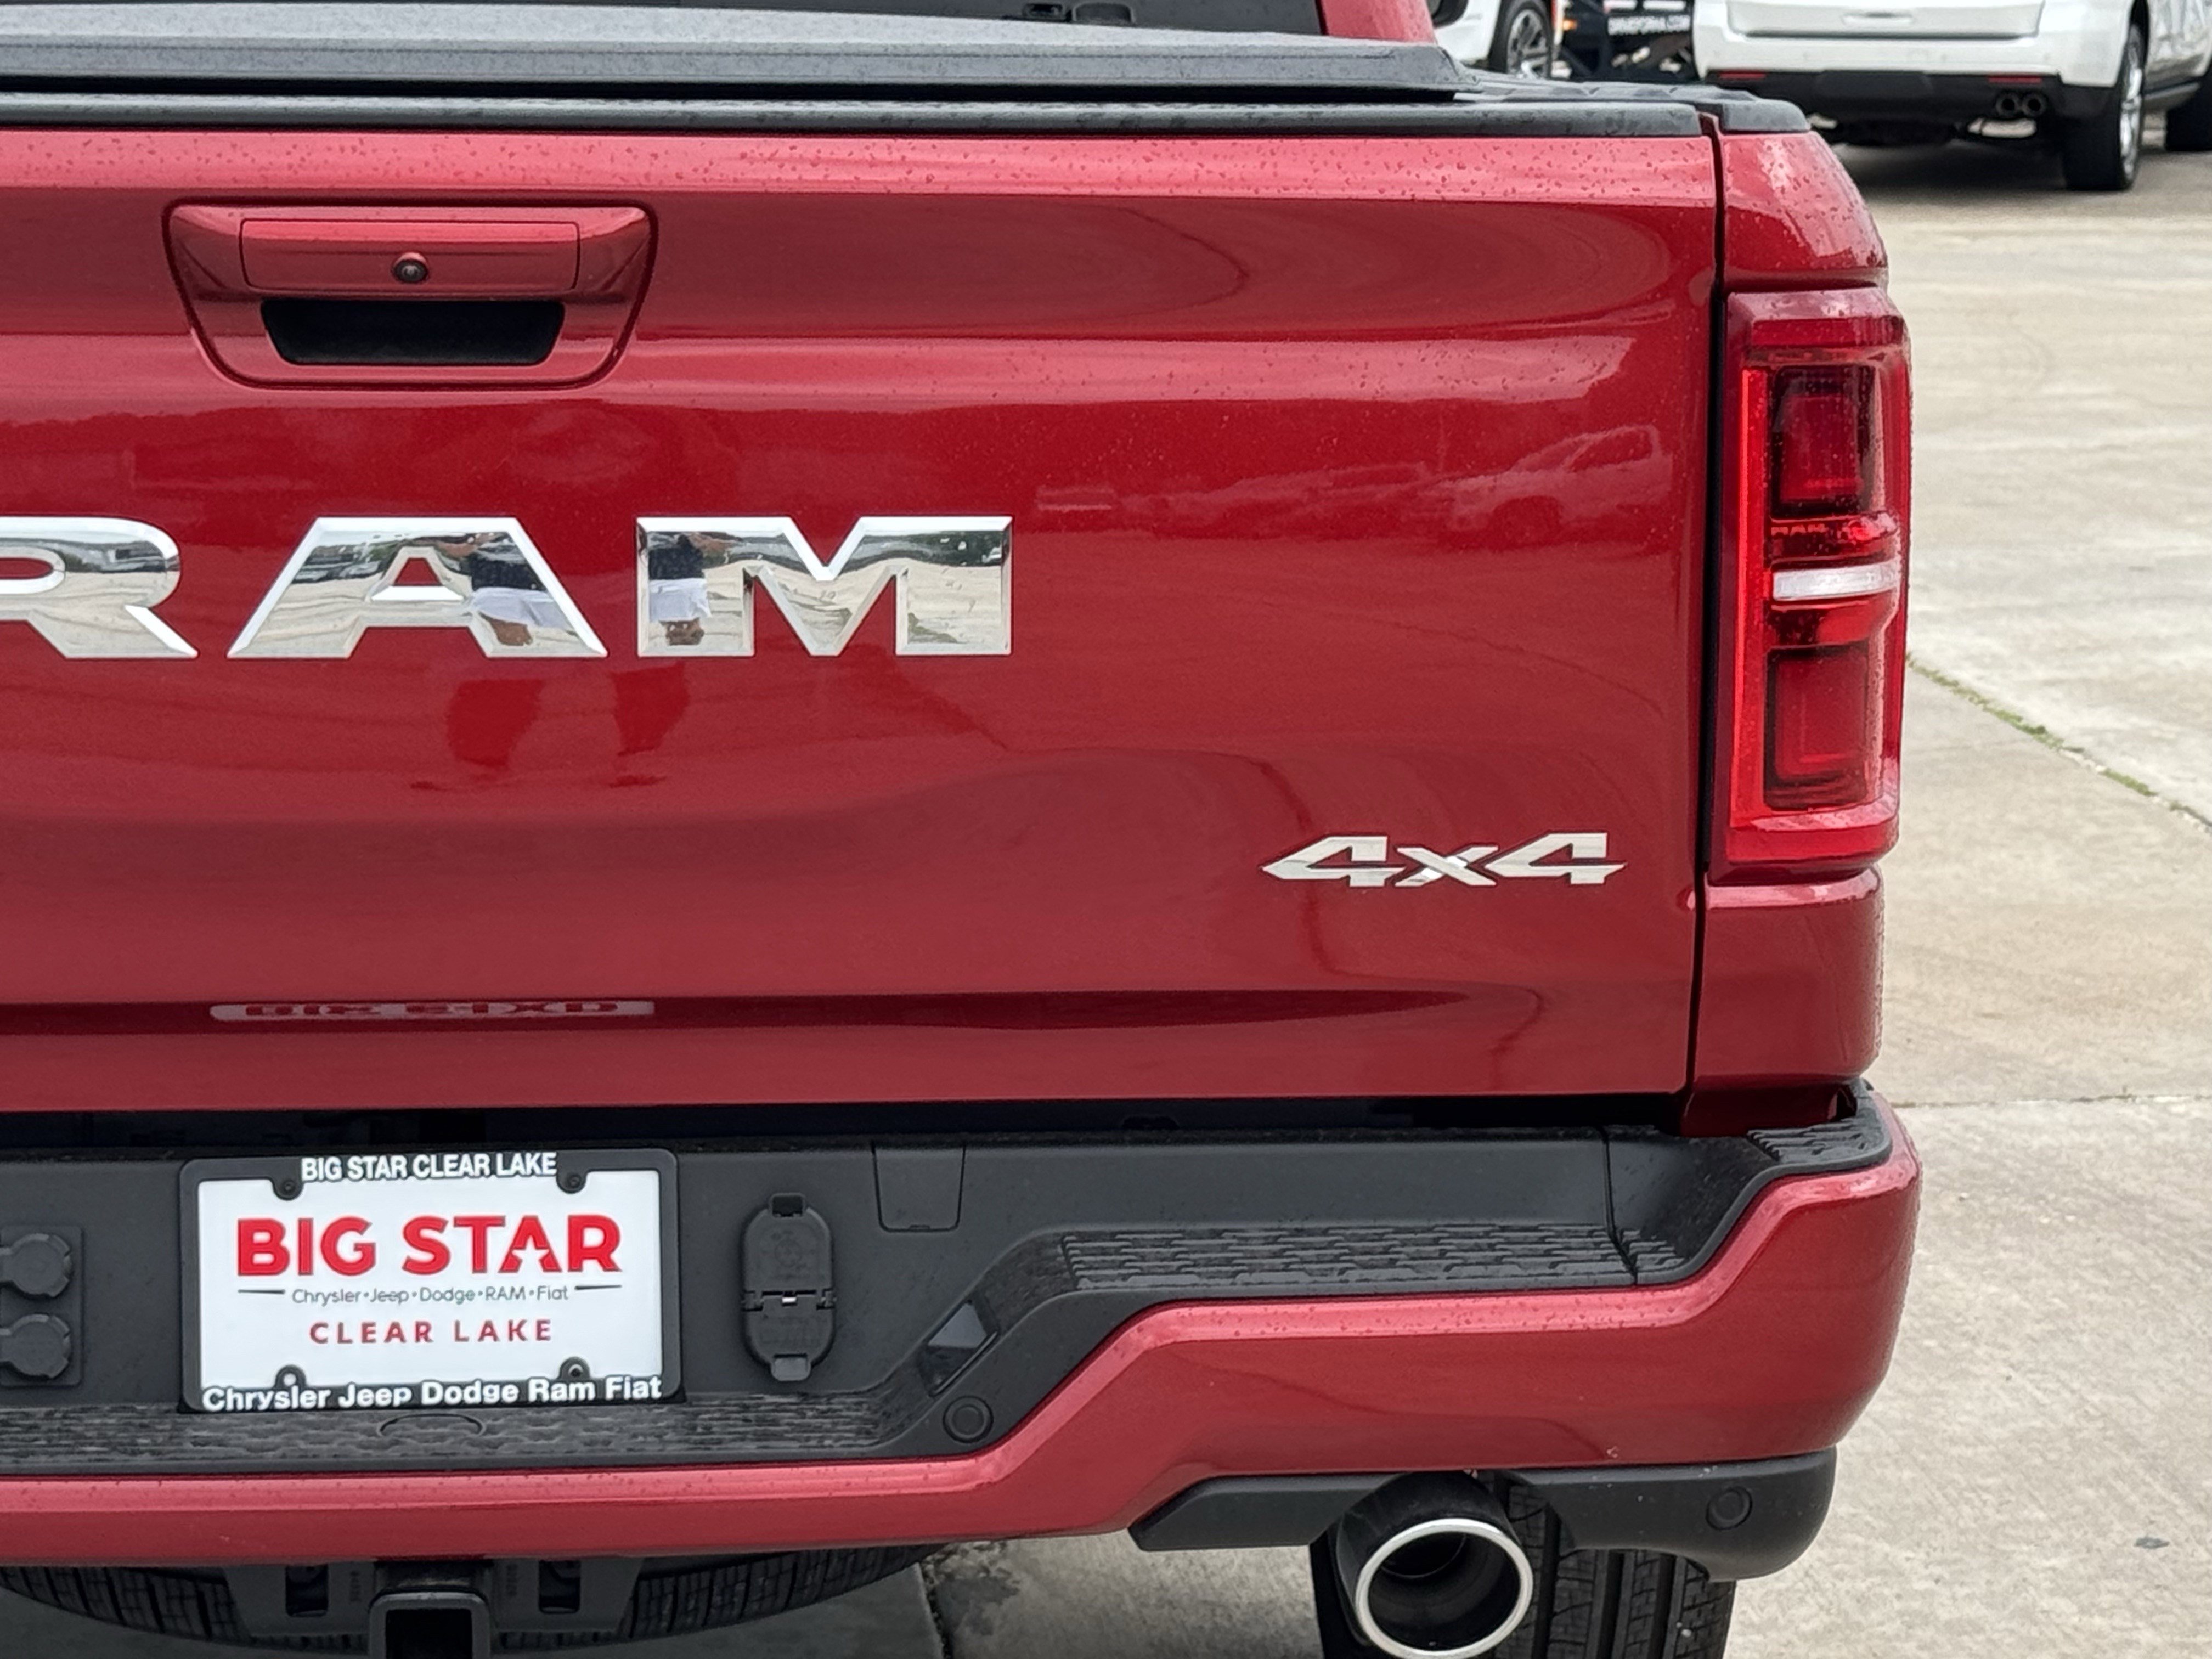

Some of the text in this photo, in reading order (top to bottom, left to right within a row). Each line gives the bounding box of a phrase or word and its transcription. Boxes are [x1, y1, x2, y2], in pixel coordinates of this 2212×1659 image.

[1262, 832, 1627, 888] 4x4
[301, 1152, 557, 1182] BIG STAR CLEAR LAKE
[237, 1214, 622, 1276] BIG STAR
[292, 1284, 569, 1306] Chrysler Jeep Dodge RAM Fiat
[309, 1318, 552, 1345] CLEAR LAKE
[201, 1376, 662, 1413] Chrysler Jeep Dodge Ram Fiat
